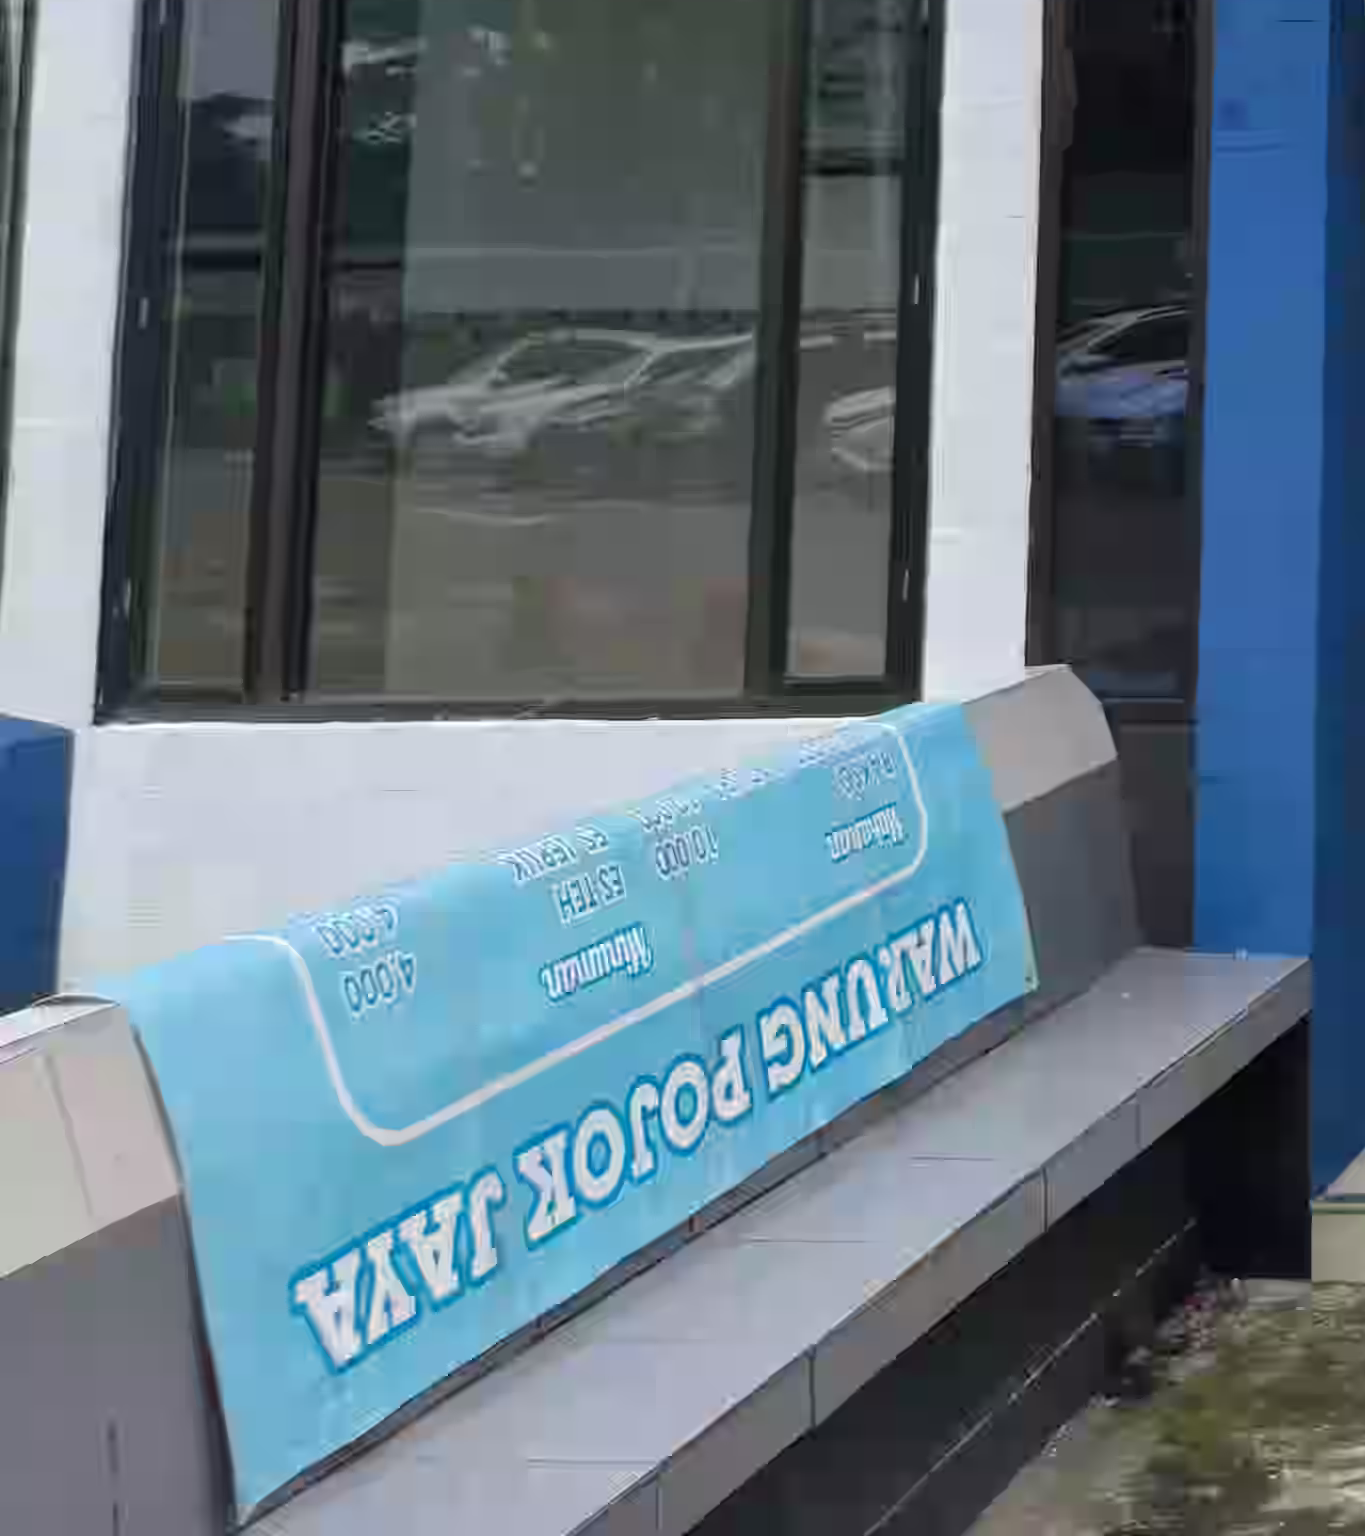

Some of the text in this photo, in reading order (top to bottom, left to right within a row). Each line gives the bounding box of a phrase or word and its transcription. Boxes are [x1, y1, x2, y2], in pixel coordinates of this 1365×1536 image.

[597, 865, 625, 906] ES
[539, 924, 653, 1005] Minuman
[289, 901, 984, 1376] WARUNG POJOK JAYA
